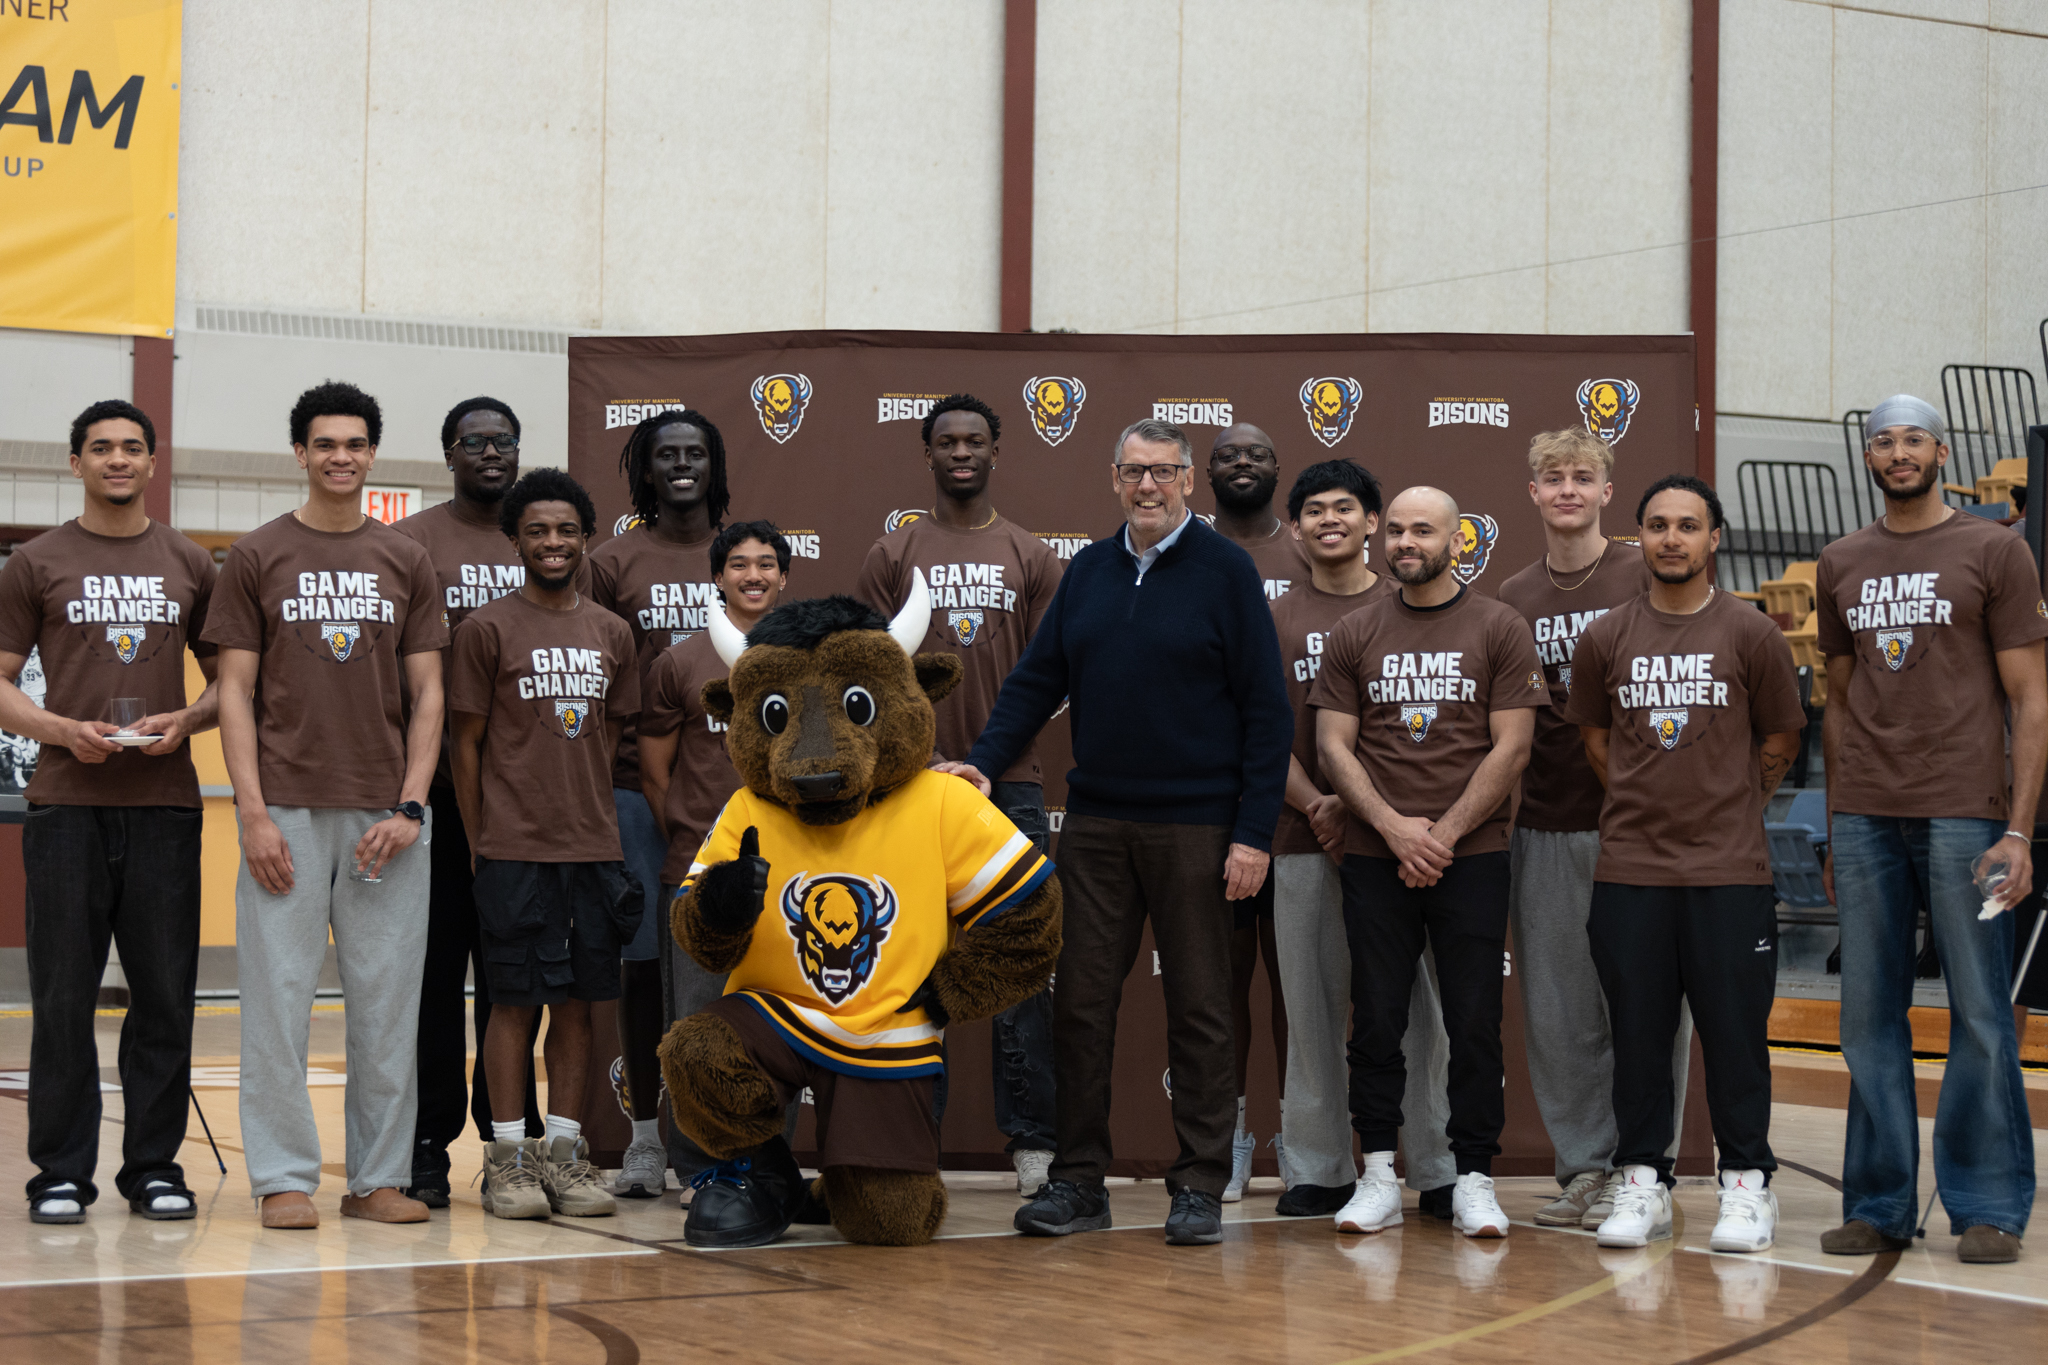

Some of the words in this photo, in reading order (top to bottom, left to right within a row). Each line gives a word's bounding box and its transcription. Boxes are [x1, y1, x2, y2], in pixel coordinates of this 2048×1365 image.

[0, 64, 145, 150] AM
[4, 156, 44, 178] UP
[883, 391, 915, 399] UNIVERSITY
[1152, 403, 1233, 428] BISONS
[1428, 402, 1509, 428] BISONS
[368, 491, 410, 524] EXIT
[83, 575, 167, 600] GAME
[299, 571, 382, 599] GAME
[930, 563, 1005, 587] GAME
[1860, 572, 1940, 605] GAME
[67, 600, 181, 625] CHANGER
[282, 597, 395, 624] CHANGER
[929, 585, 1017, 613] HANGER
[1846, 599, 1953, 632] CHANGER
[531, 647, 604, 675] GAME
[1382, 652, 1464, 679] GAME
[1630, 653, 1715, 683] GAME
[26, 673, 35, 681] 33
[1368, 677, 1477, 704] CHANGER
[1617, 681, 1729, 710] CHANGER
